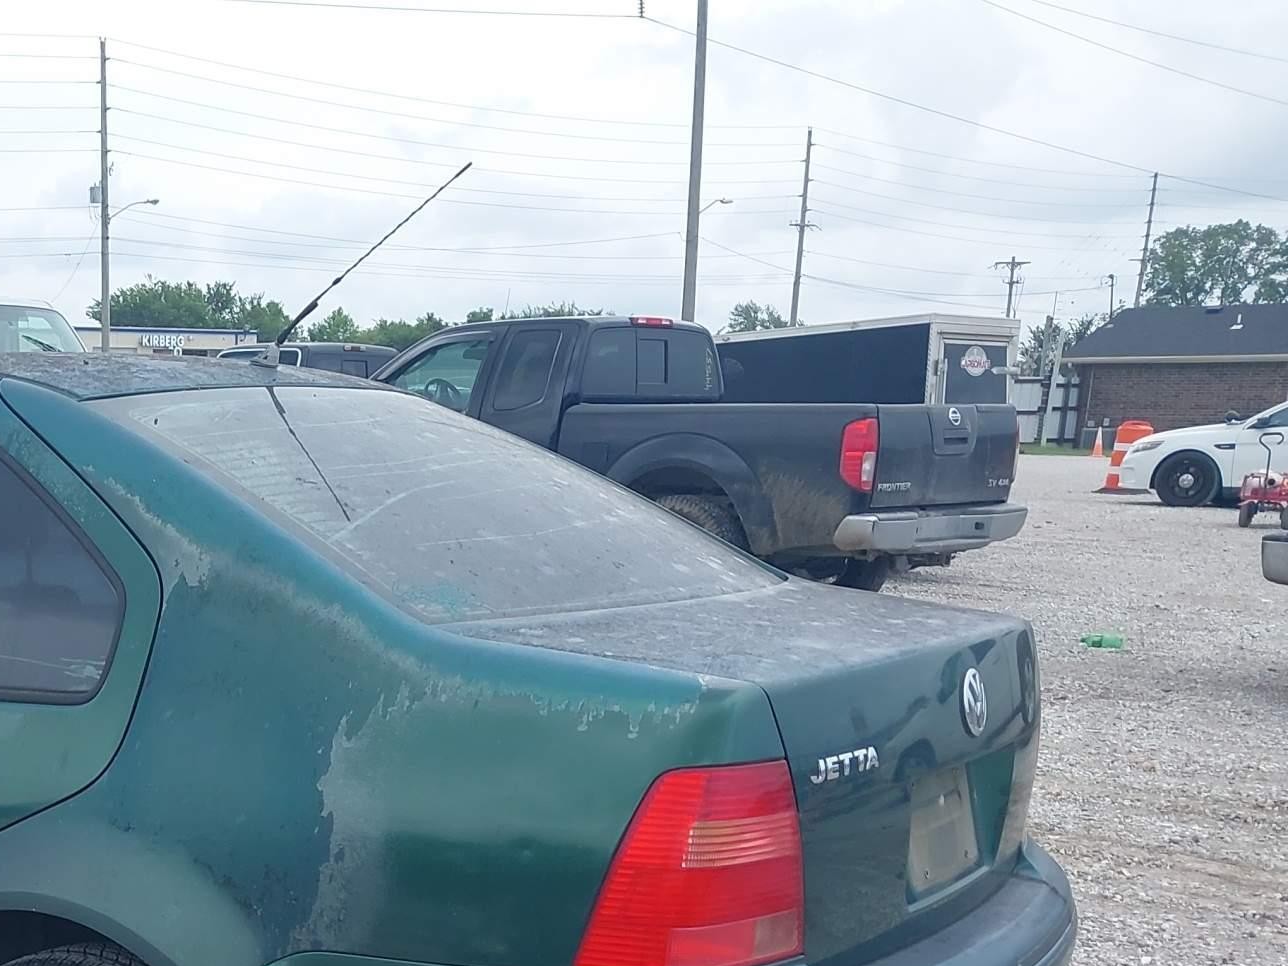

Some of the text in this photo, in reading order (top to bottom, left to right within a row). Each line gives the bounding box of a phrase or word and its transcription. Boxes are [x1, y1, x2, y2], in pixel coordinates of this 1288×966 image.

[142, 335, 185, 347] KIRBERG
[877, 482, 912, 492] FRONTIER
[810, 746, 880, 784] JETTA
